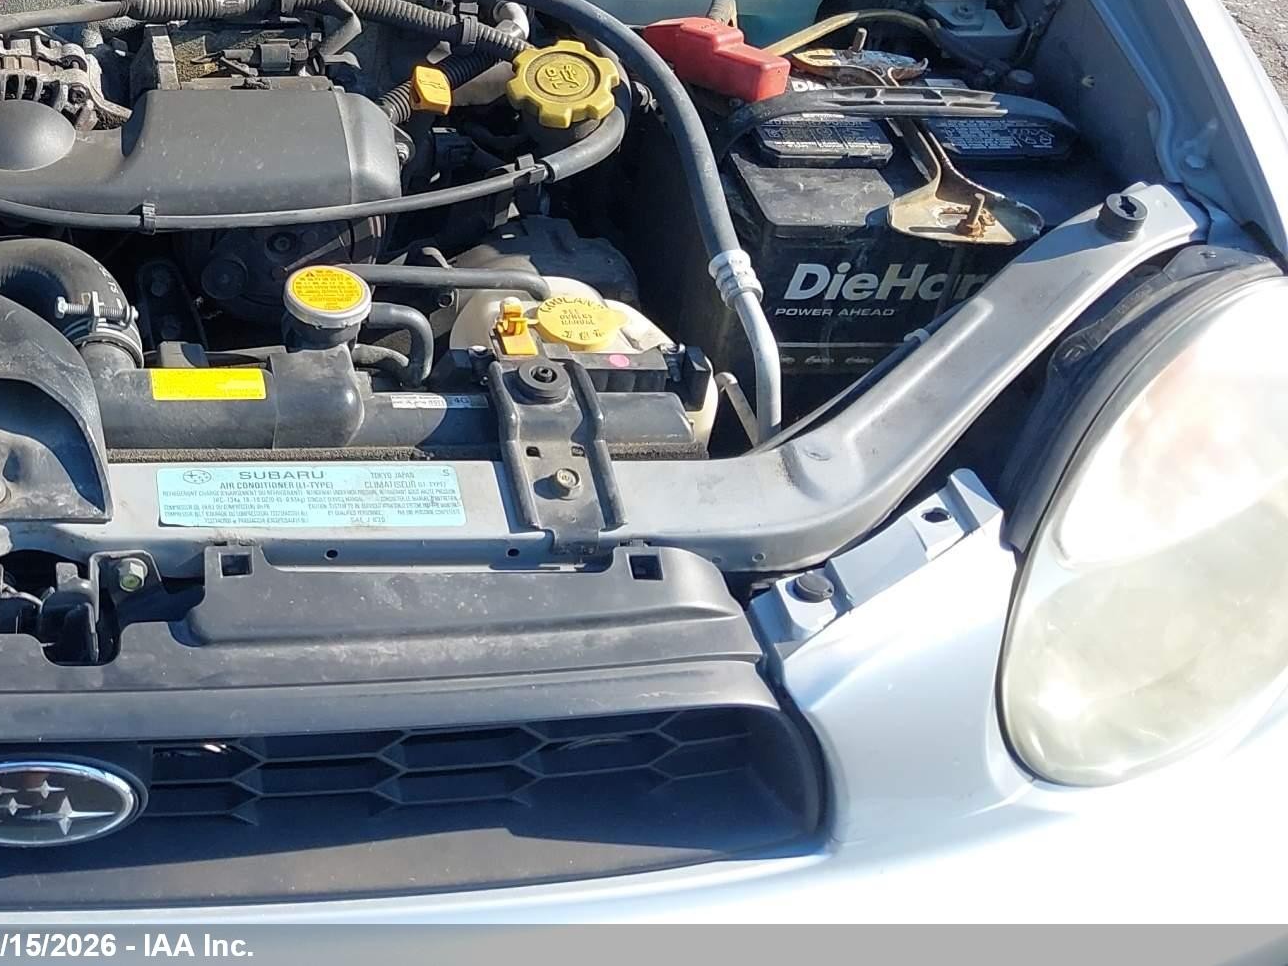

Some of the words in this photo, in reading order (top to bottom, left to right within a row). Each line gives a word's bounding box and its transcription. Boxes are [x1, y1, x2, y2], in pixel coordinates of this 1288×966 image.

[545, 67, 563, 89] OIL
[783, 261, 990, 301] DieHar
[774, 307, 834, 317] POWER
[838, 307, 896, 317] AHEAD
[239, 470, 325, 480] SUBARU
[369, 471, 393, 479] TOKYO
[395, 471, 416, 479] JAPAN
[219, 481, 235, 490] AIR
[236, 481, 294, 490] CONDITIONER
